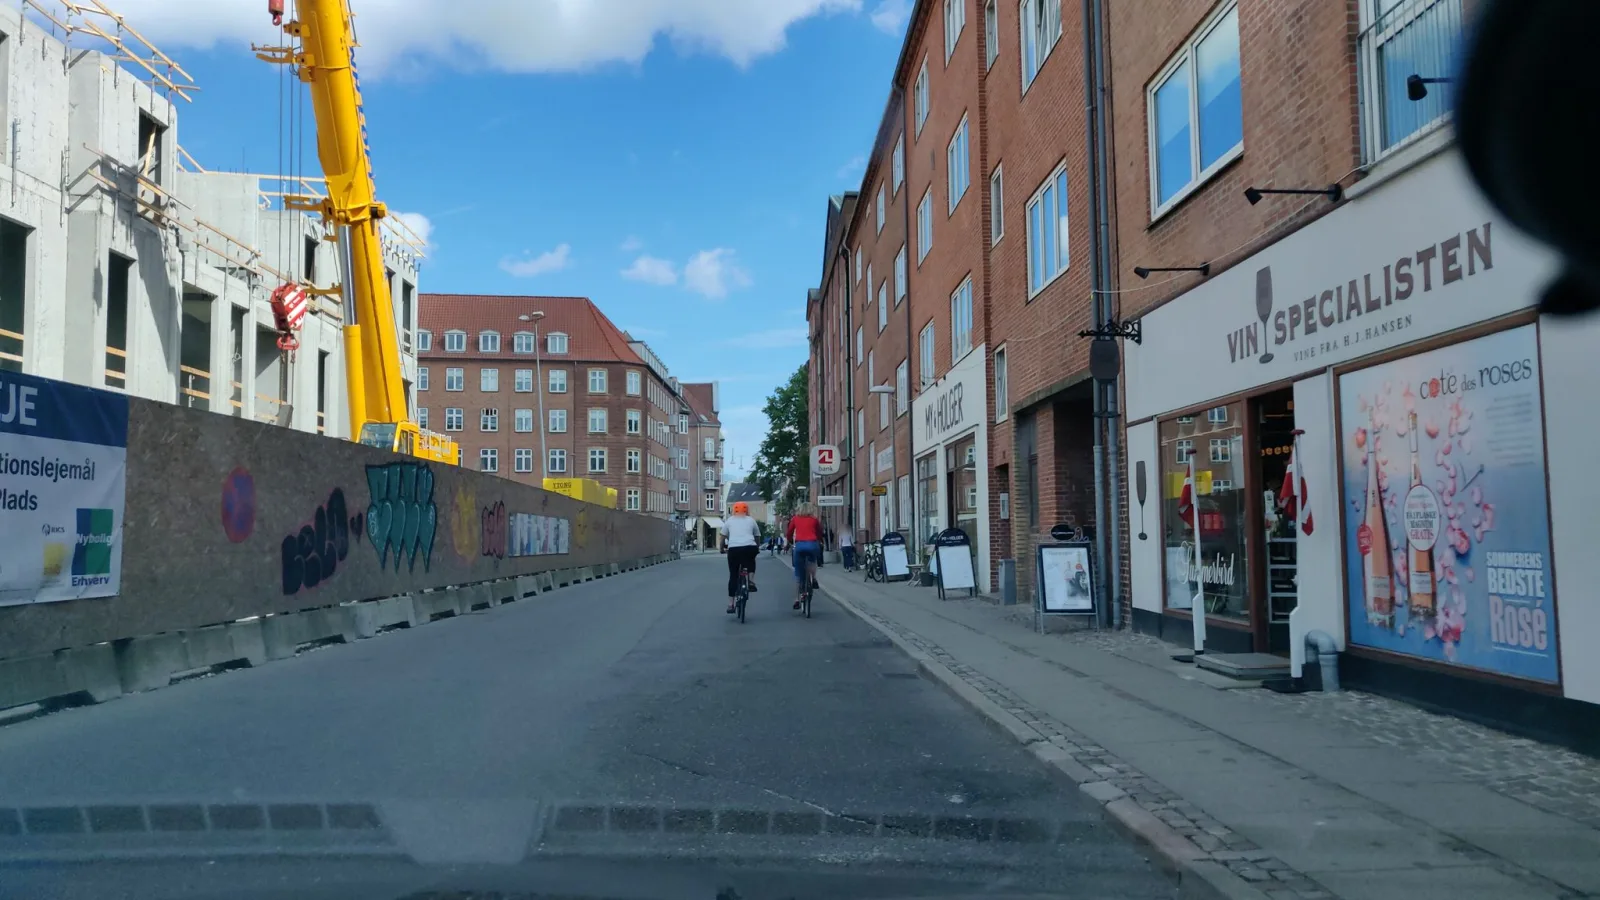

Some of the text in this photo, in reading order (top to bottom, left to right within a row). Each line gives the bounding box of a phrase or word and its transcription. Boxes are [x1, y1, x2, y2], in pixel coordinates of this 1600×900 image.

[1227, 222, 1494, 363] VIN SPECIALISTEN
[1294, 347, 1316, 362] VINE
[1320, 341, 1339, 355] FRA
[1461, 373, 1477, 392] des
[1479, 358, 1533, 388] roses
[0, 382, 38, 427] JE
[925, 402, 933, 441] MY
[937, 381, 964, 435] HOLGER
[0, 488, 38, 511] lads
[1486, 551, 1542, 569] SOMMERENS
[71, 576, 110, 587] Erhverv
[1487, 567, 1545, 598] BEDSTE
